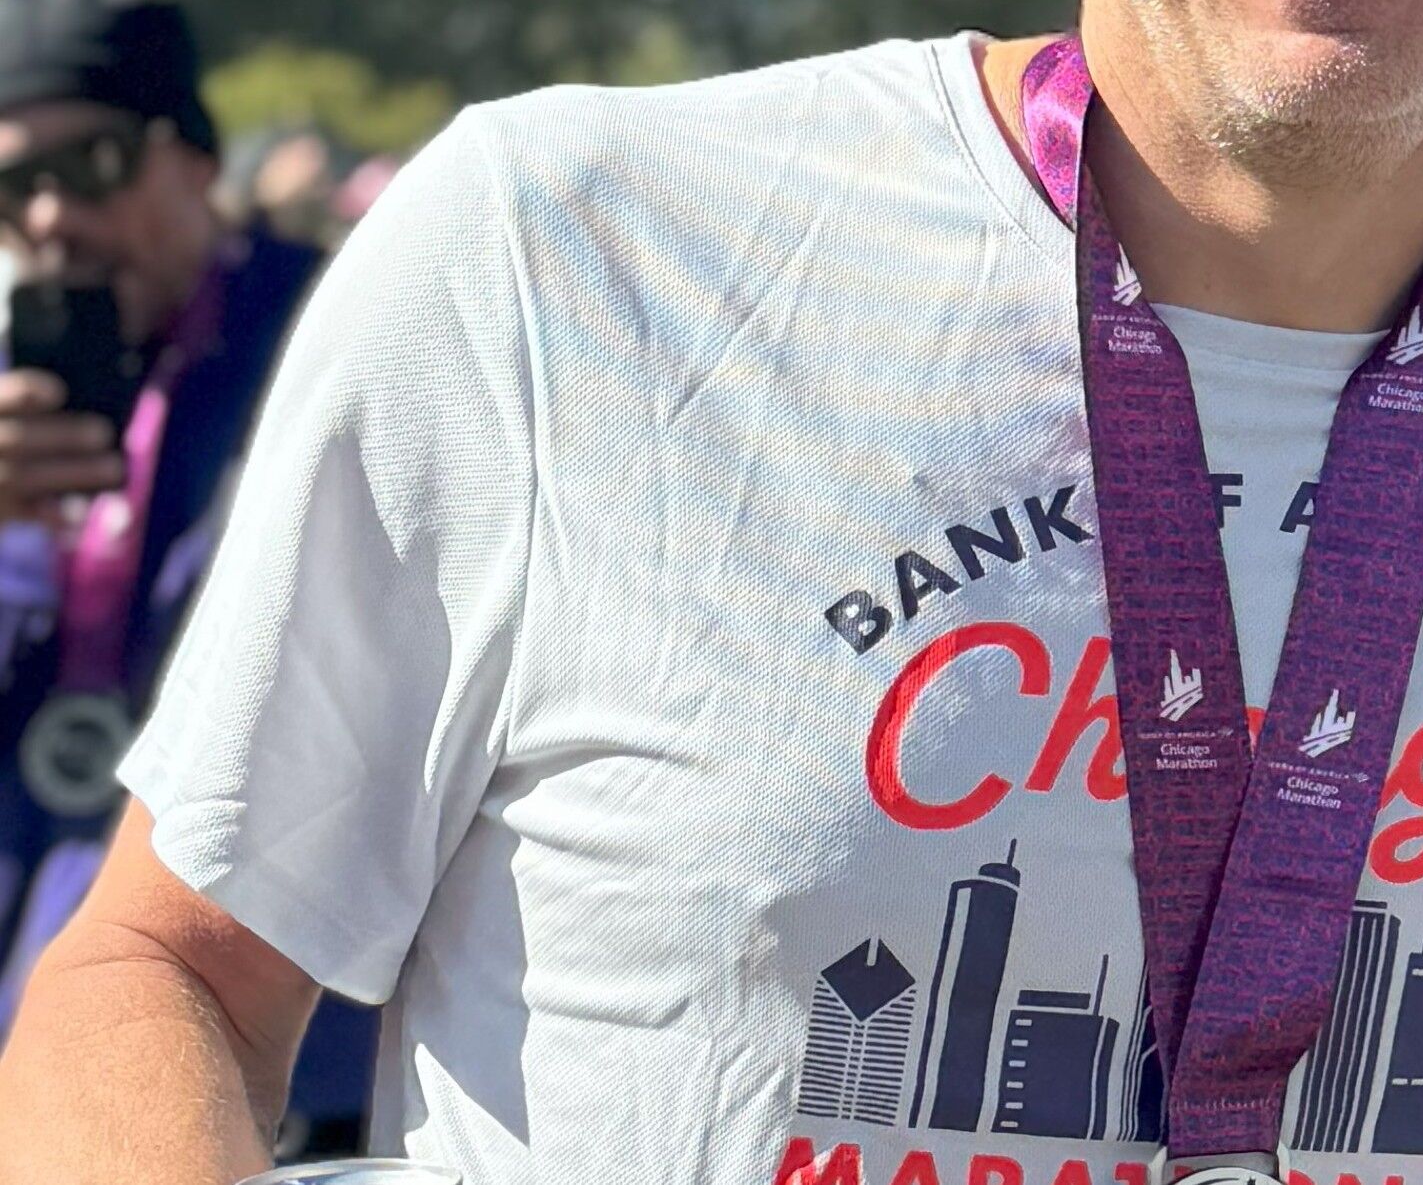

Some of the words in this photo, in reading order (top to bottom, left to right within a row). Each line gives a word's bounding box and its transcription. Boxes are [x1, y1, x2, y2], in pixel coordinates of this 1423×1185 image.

[824, 484, 1095, 656] BANK
[1160, 742, 1211, 758] Chicago
[1155, 757, 1218, 771] Marathon
[1286, 776, 1340, 797] Chicago
[1277, 787, 1342, 810] Marathon
